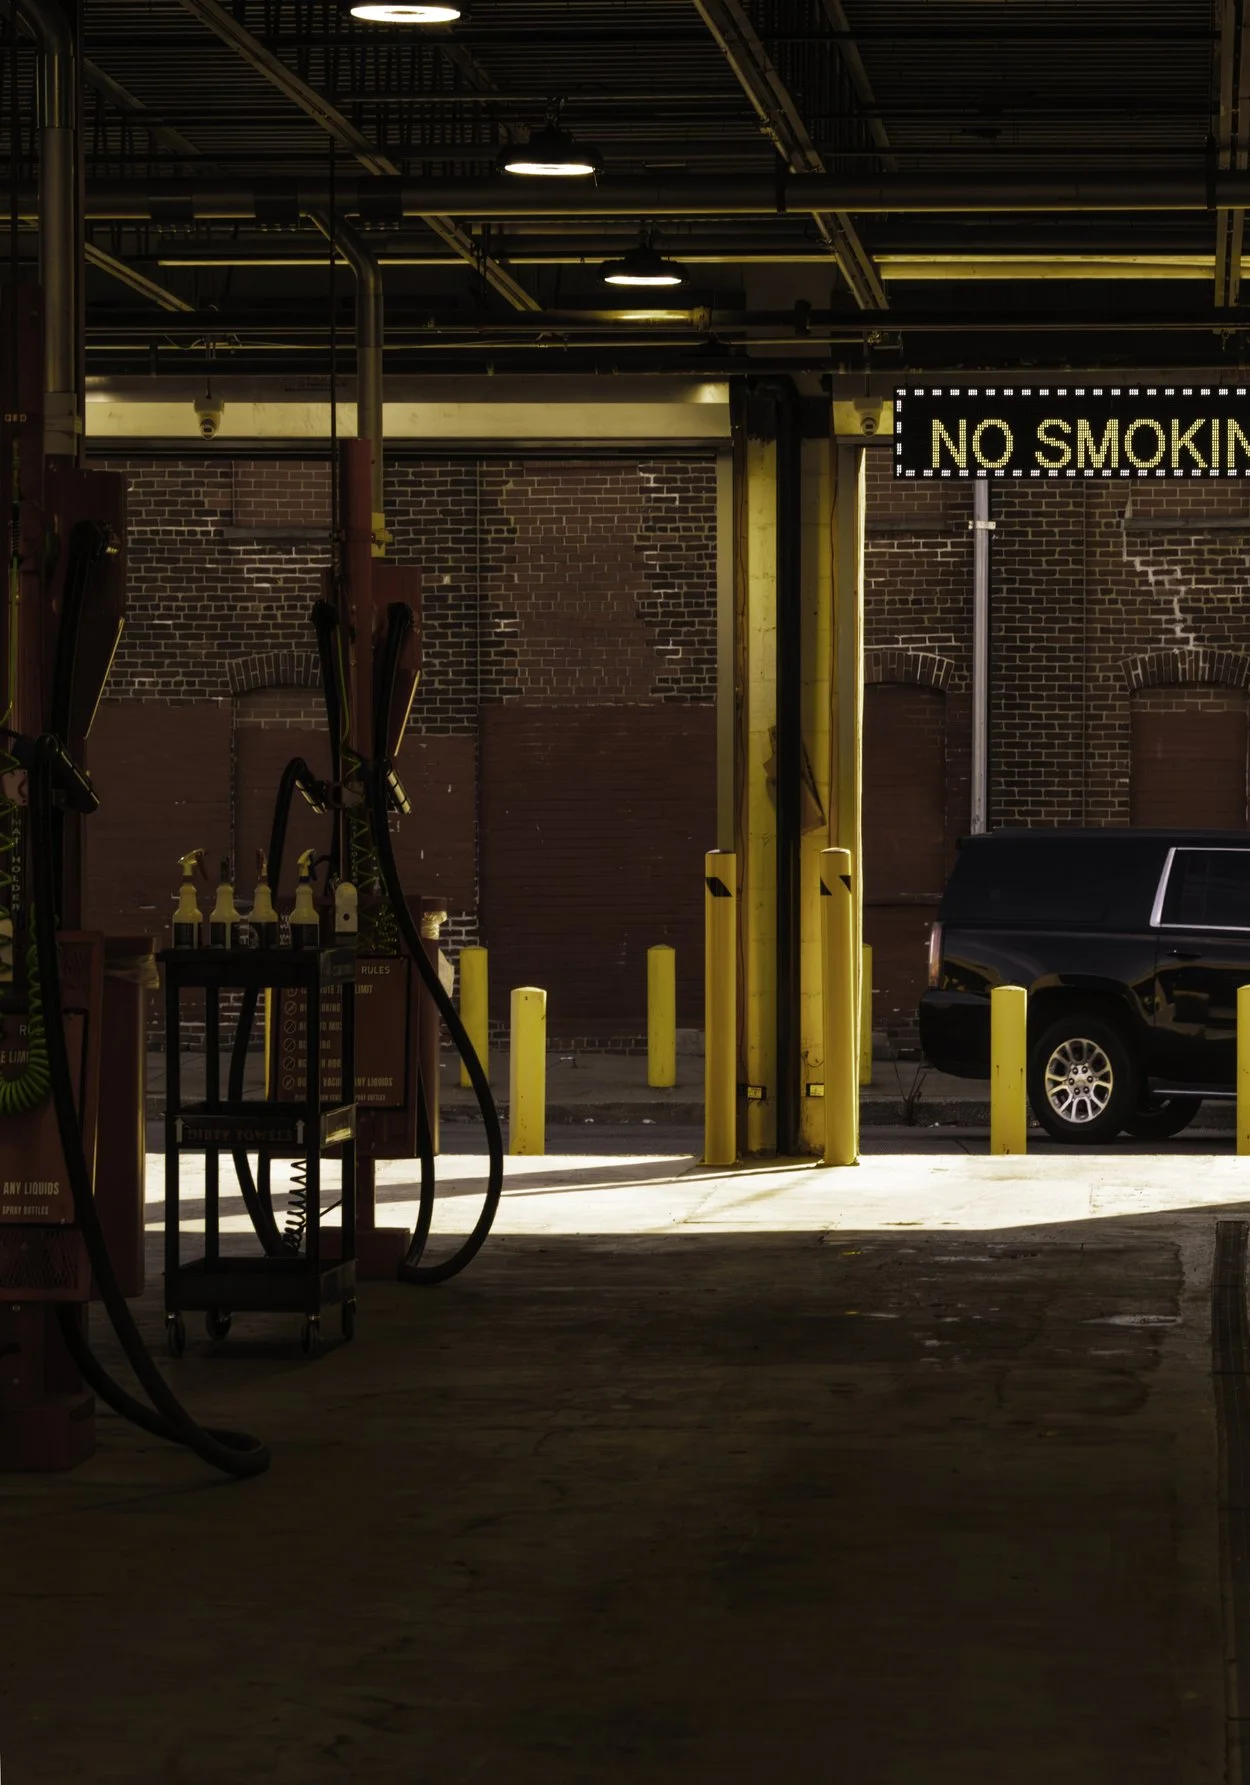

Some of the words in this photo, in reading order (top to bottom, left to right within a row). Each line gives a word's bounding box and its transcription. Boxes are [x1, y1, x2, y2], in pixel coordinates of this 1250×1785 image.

[930, 418, 1013, 468] NO
[361, 966, 390, 975] RULES
[188, 1128, 230, 1141] DIRTY
[3, 1181, 21, 1195] ANY
[24, 1181, 59, 1195] LIQUIDS
